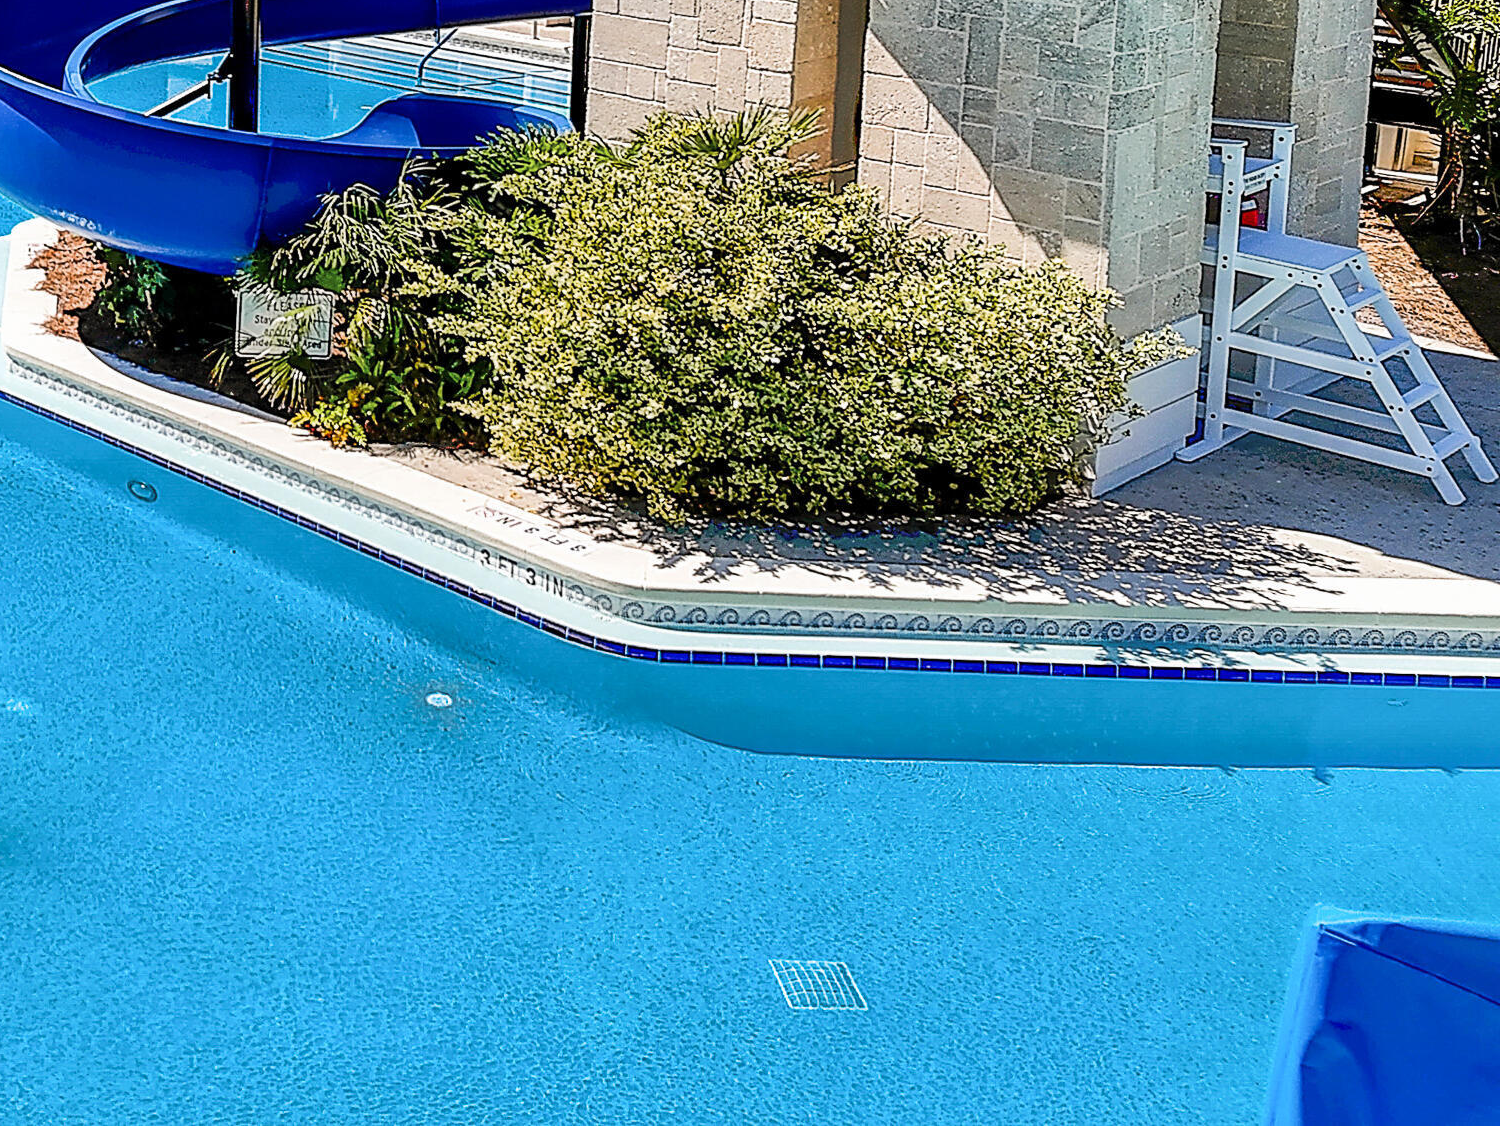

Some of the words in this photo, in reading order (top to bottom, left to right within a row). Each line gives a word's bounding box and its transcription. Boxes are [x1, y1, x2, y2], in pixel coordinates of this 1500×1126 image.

[480, 548, 491, 567] 3
[498, 556, 518, 579] FT
[525, 567, 536, 586] 3
[545, 573, 565, 598] IN
